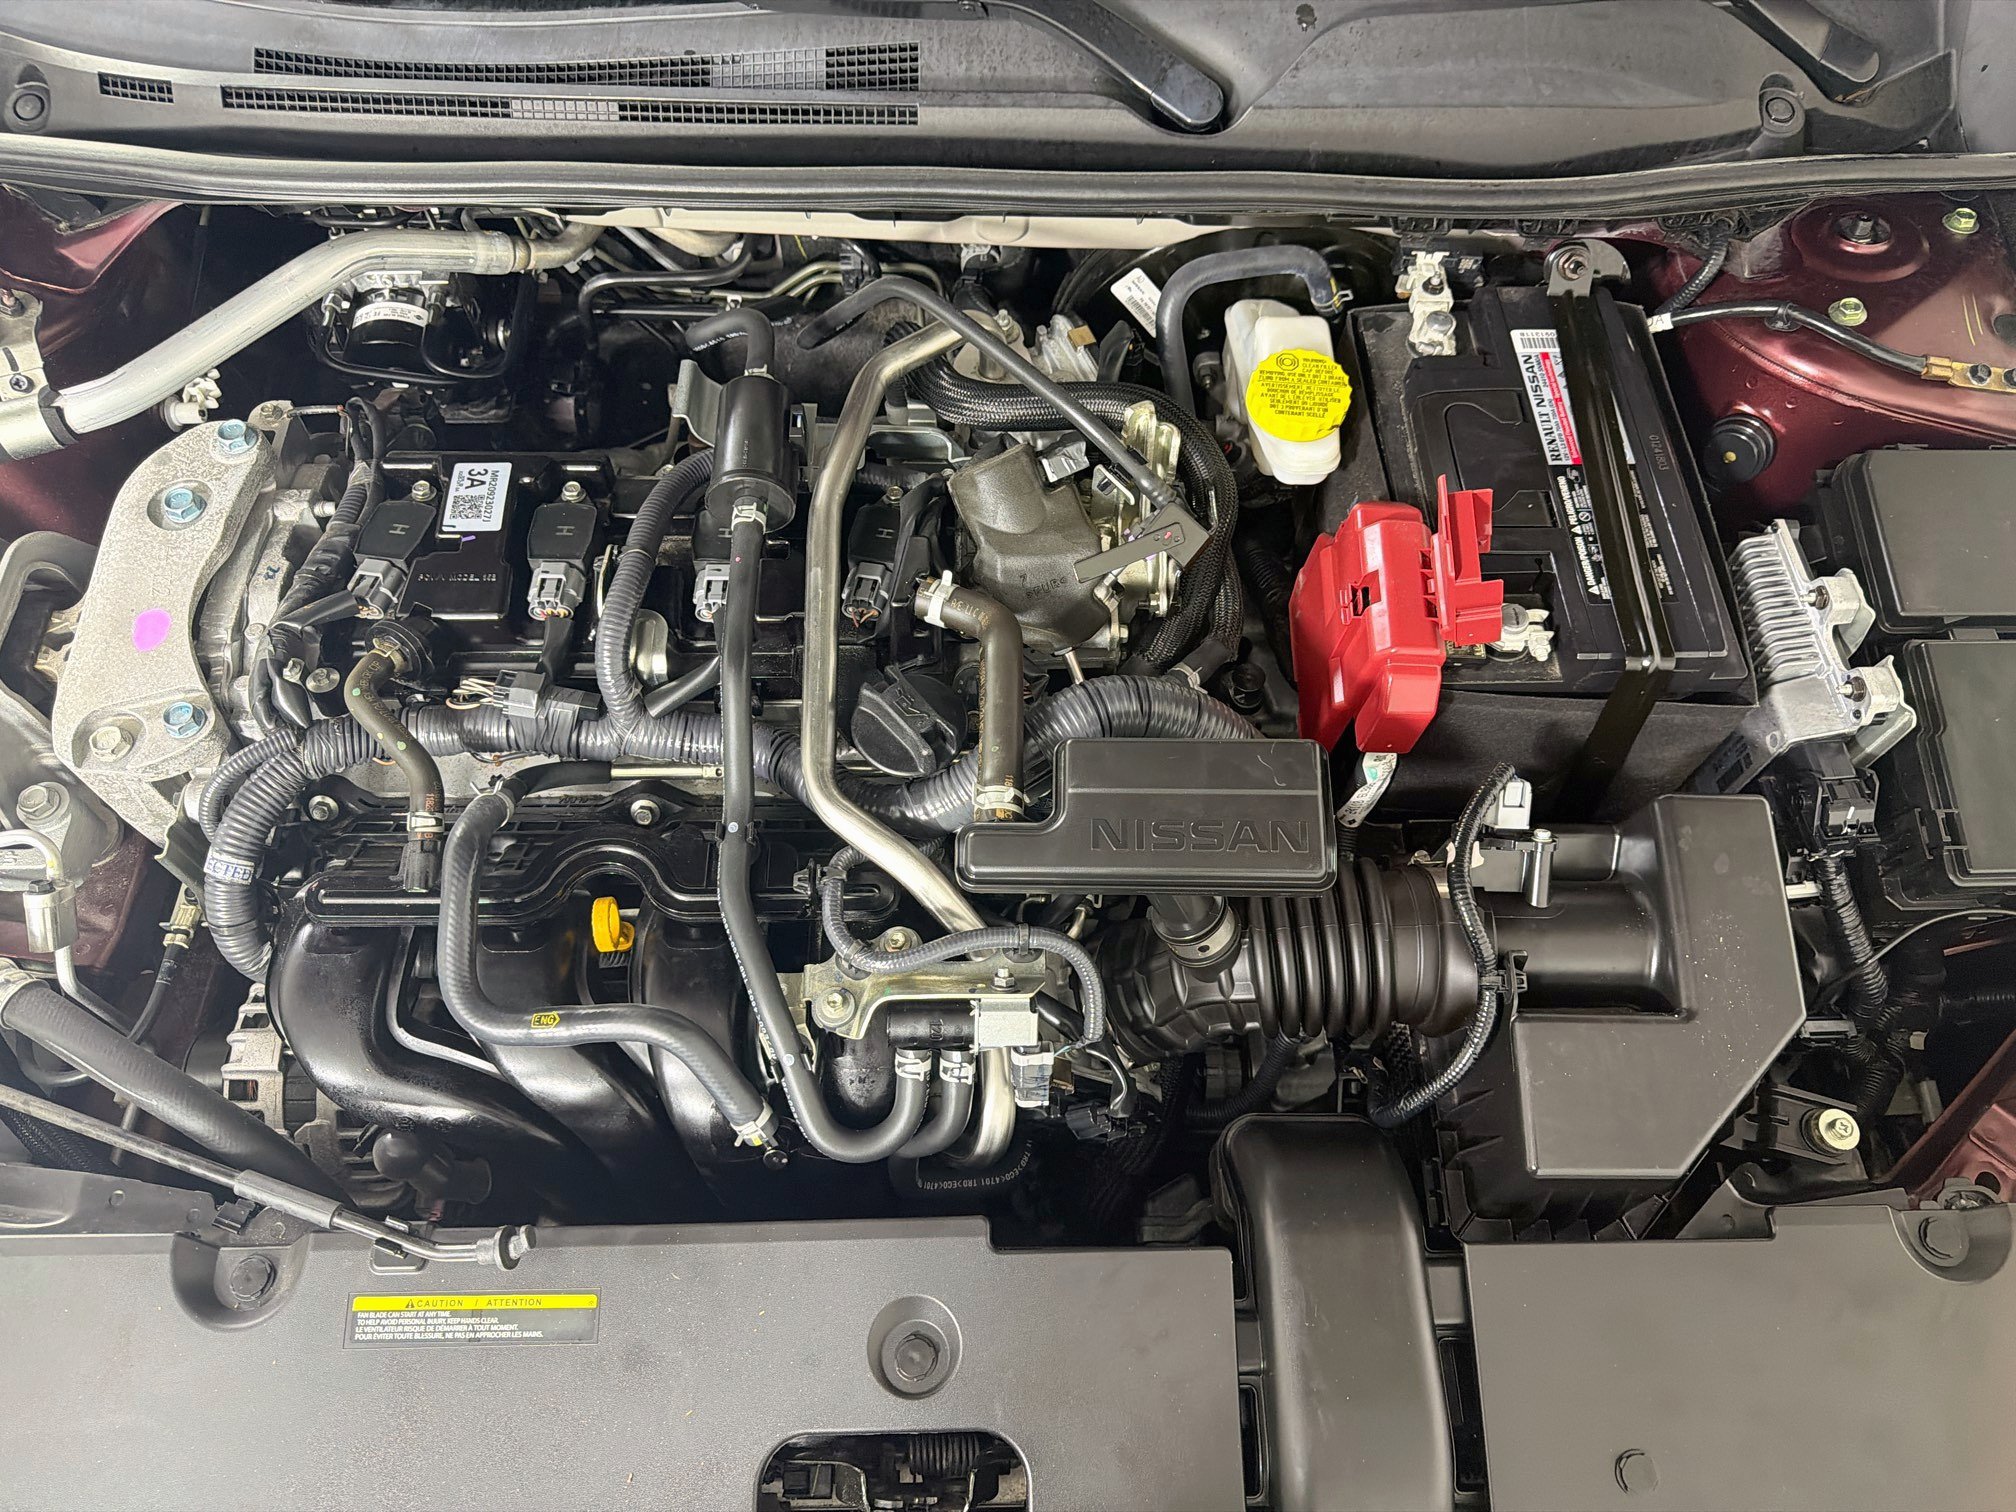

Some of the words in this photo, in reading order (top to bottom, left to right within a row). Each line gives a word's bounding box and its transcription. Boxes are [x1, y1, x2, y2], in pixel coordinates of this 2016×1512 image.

[1521, 354, 1546, 407] NISSAN
[1537, 412, 1562, 461] RENAULT
[465, 468, 489, 490] 3A
[1090, 818, 1310, 853] NISSAN
[534, 1015, 554, 1025] ENG
[417, 1299, 463, 1307] CAUTION
[486, 1298, 542, 1307] ATTENTION
[373, 1332, 393, 1340] ÉVITER
